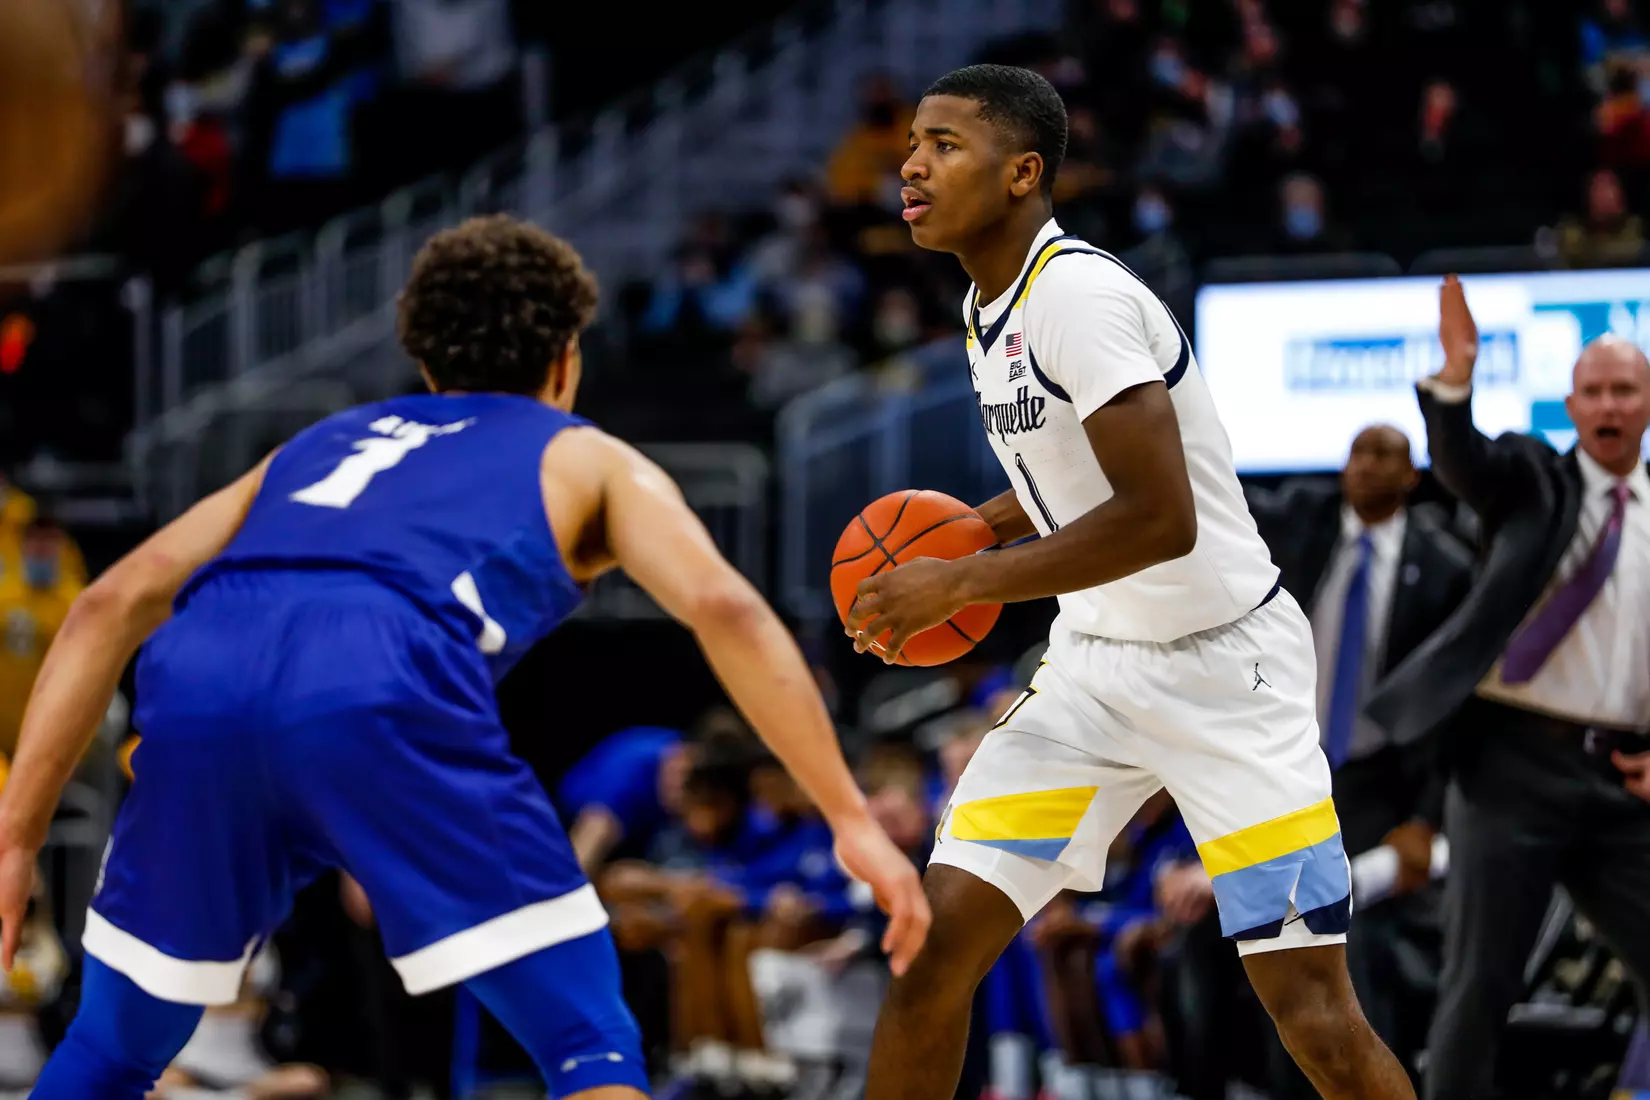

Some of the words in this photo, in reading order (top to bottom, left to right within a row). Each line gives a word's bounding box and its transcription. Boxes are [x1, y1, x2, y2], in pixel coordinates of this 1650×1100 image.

[1009, 360, 1022, 371] BIG
[1008, 366, 1027, 378] EAST
[1015, 453, 1059, 533] 1
